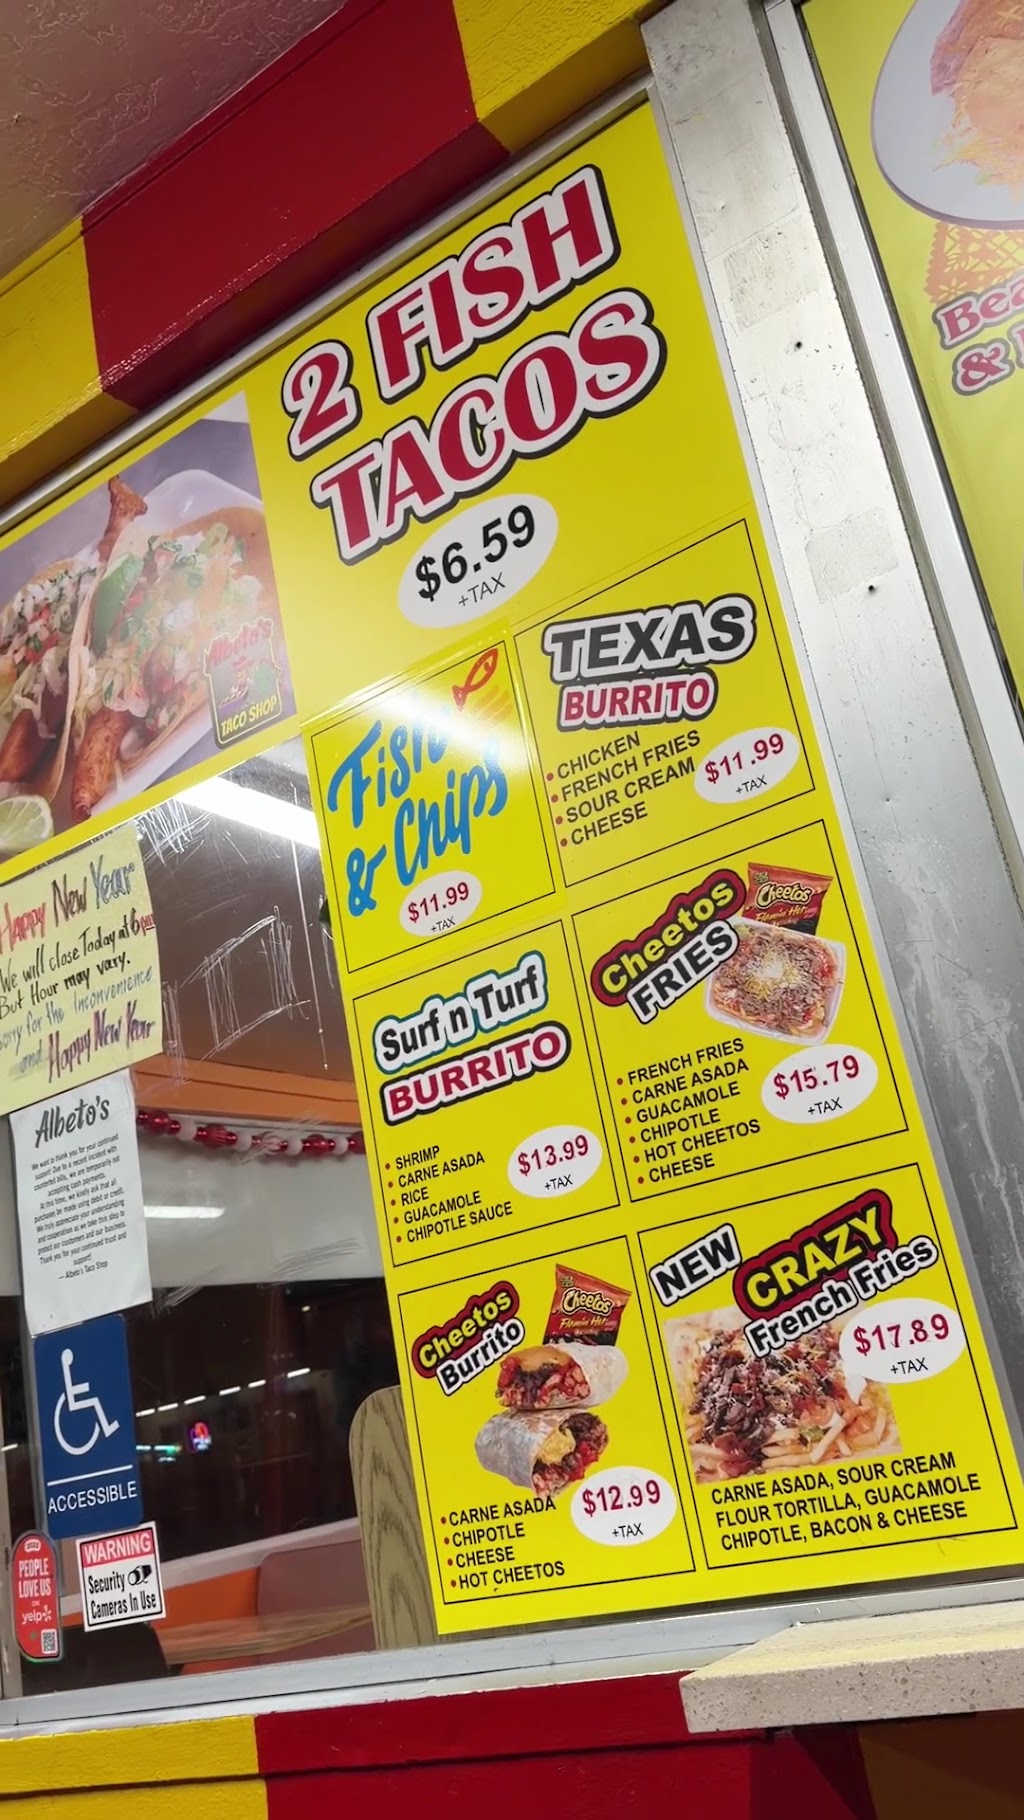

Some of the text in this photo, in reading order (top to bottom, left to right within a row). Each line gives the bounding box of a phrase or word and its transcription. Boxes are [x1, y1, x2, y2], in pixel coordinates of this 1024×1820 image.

[289, 176, 607, 450] 2 FISH
[960, 346, 1006, 388] &
[317, 299, 653, 553] TACOS
[414, 504, 536, 602] $6.59
[457, 572, 507, 607] +TAX
[549, 604, 747, 675] TEXAS
[220, 694, 278, 738] TACO SHOP
[562, 676, 712, 723] BURRITO
[557, 731, 641, 780] CHICKEN
[561, 730, 702, 802] FRENCH FRIES
[704, 733, 785, 785] $11.99
[566, 756, 696, 823] SOUR CREAM
[735, 774, 768, 796] +TAX
[346, 738, 508, 918] & Chips
[571, 802, 649, 845] CHEESE
[0, 854, 136, 955] Happy New Year
[407, 881, 469, 924] $11.99
[757, 882, 812, 908] Cheetos
[430, 916, 457, 934] +TAX
[599, 880, 736, 996] Cheetos
[0, 957, 18, 994] We
[23, 943, 45, 982] will
[49, 941, 81, 972] close
[78, 926, 116, 957] Today
[118, 914, 130, 941] at
[629, 923, 735, 1018] FRIES
[0, 951, 131, 1020] But Hour may vary.
[26, 1010, 43, 1037] for
[46, 1001, 65, 1026] the
[380, 964, 540, 1063] Surf n Turf
[48, 1029, 91, 1083] Happy
[93, 1007, 122, 1052] New
[125, 999, 156, 1050] Year
[627, 1037, 745, 1085] FRENCH FRIES
[387, 1030, 563, 1117] BURRITO
[632, 1058, 749, 1105] CARNE ASADA
[773, 1054, 860, 1100] $15.79
[34, 1094, 111, 1149] Albeto's
[636, 1081, 741, 1125] GUACAMOLE
[806, 1096, 843, 1117] +TAX
[640, 1108, 721, 1143] CHIPOTLE
[644, 1119, 761, 1164] HOT CHEETOS
[395, 1145, 441, 1170] SHRIMP
[398, 1151, 486, 1189] CARNE ASADA
[517, 1133, 589, 1178] $13.99
[648, 1153, 716, 1184] CHEESE
[401, 1186, 430, 1207] RICE
[544, 1175, 574, 1192] +TAX
[403, 1191, 482, 1225] GUACAMOLE
[406, 1201, 514, 1243] CHIPOTLE SAUCE
[653, 1229, 740, 1302] NEW
[745, 1205, 886, 1309] CRAZY
[562, 1288, 612, 1314] Cheetos
[749, 1237, 936, 1354] French Fries
[418, 1290, 512, 1370] Cheetos
[852, 1313, 950, 1356] $17.89
[438, 1322, 522, 1391] Burrito
[889, 1357, 929, 1376] +TAX
[47, 1480, 138, 1514] ACCESSIBLE
[582, 1479, 662, 1518] $12.99
[711, 1451, 957, 1505] CARNE ASADA, SOUR CREAM
[449, 1495, 557, 1527] CARNE ASADA
[715, 1472, 982, 1529] FLOUR TORTILLA, GUACAMOLE
[83, 1532, 152, 1565] WARNING
[452, 1522, 526, 1547] CHIPOTLE
[611, 1523, 644, 1539] +TAX
[721, 1501, 969, 1552] CHIPOTLE, BACON & CHEESE
[18, 1557, 49, 1578] PEOPLE
[455, 1546, 516, 1569] CHEESE
[458, 1561, 566, 1590] HOT CHEETOS
[18, 1577, 52, 1599] LOVE US
[88, 1570, 126, 1596] Security
[90, 1590, 158, 1620] Cameras In Use
[21, 1608, 43, 1625] yelp
